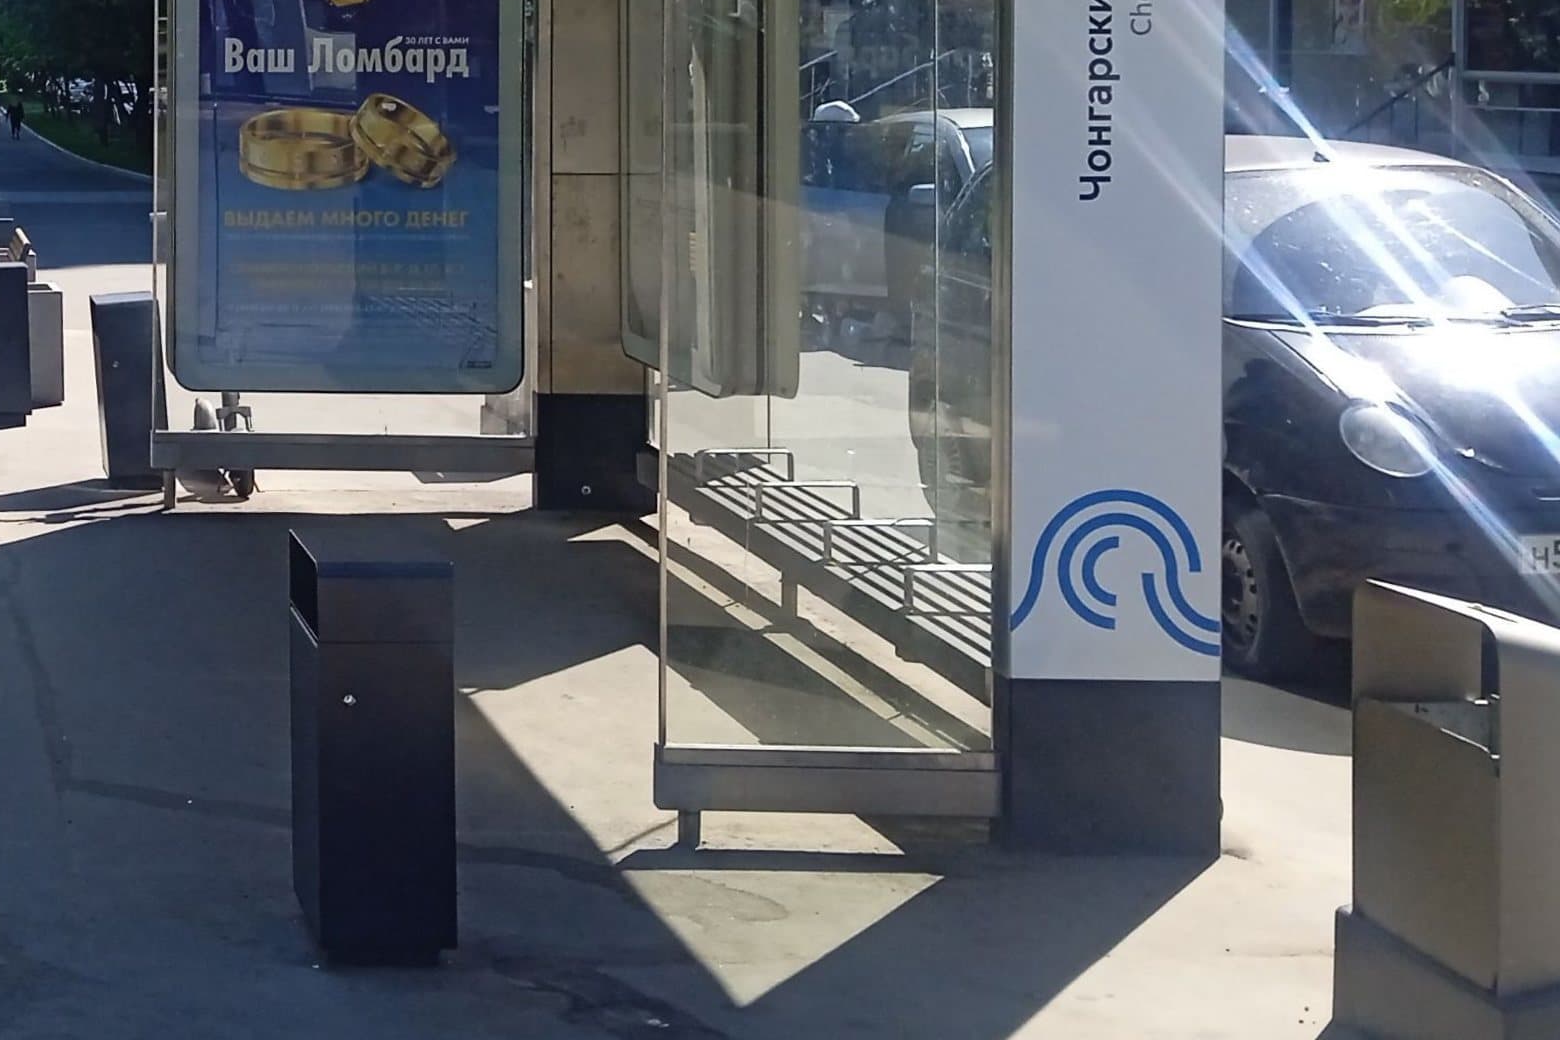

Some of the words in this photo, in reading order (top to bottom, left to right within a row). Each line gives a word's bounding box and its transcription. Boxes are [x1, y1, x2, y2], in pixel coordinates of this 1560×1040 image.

[224, 37, 294, 73] Ваш
[307, 36, 469, 83] Ломбард
[223, 211, 314, 229] ВЫДАЕМ
[321, 211, 400, 228] МНОГО
[405, 210, 469, 230] ДЕНЕГ
